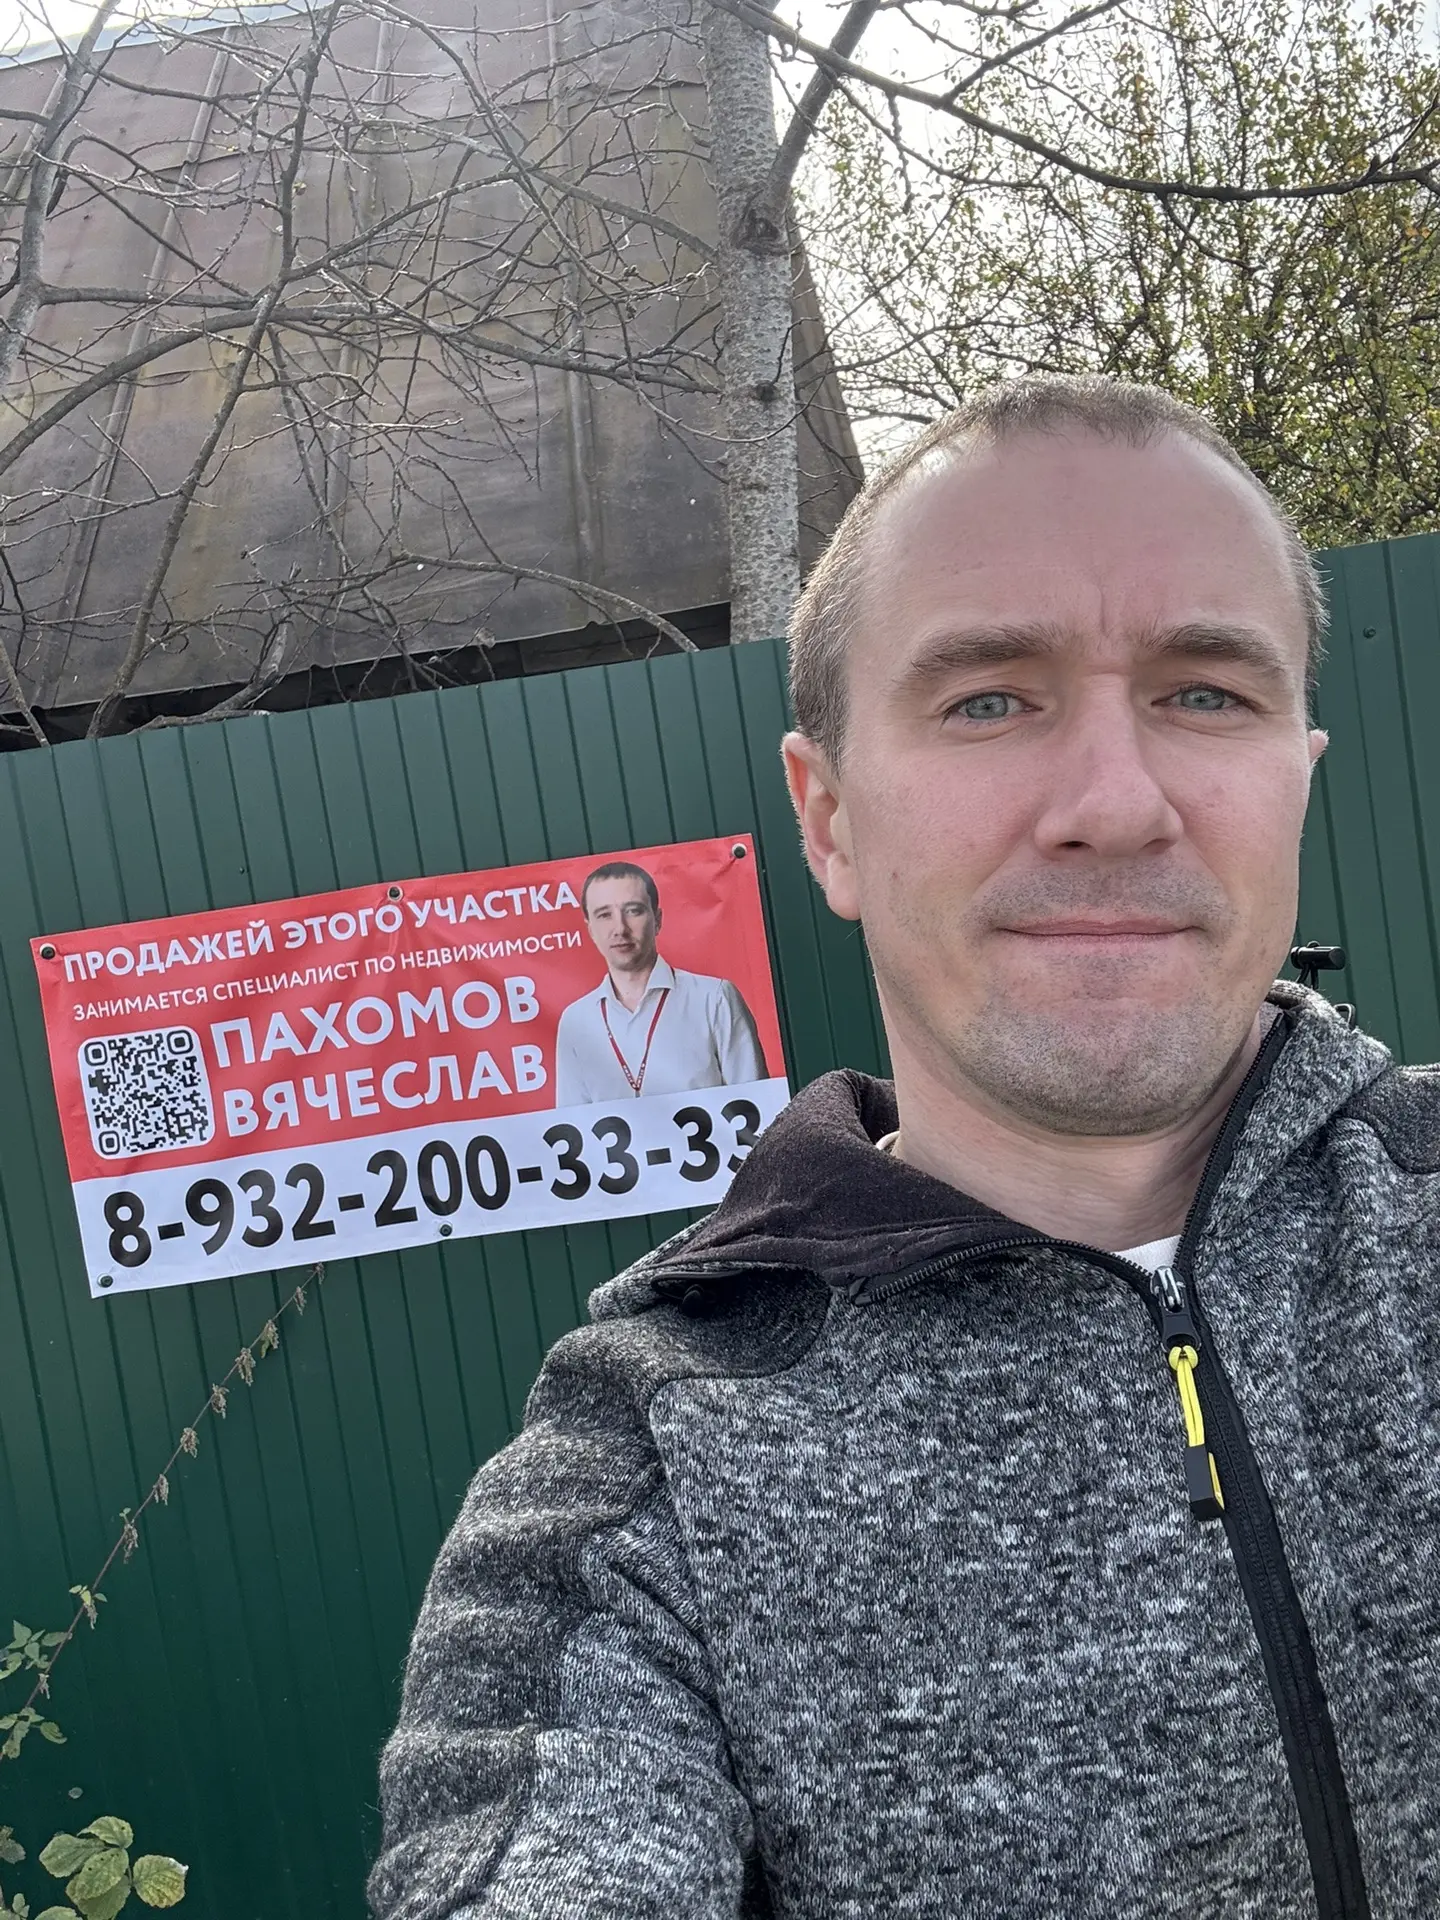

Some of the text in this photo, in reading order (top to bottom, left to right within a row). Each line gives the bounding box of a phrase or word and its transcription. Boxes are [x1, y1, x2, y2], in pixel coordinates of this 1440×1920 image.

[64, 881, 580, 982] ПРОДАЖЕЙ ЭТОГО УЧАСТКА
[73, 930, 582, 1021] ЗАНИМАЕТСЯ СПЕЦИАЛИСТ ПО НЕДВИЖИМОСТИ
[210, 975, 540, 1068] ПАХОМОВ
[223, 1044, 547, 1137] ВЯЧЕСЛАВ
